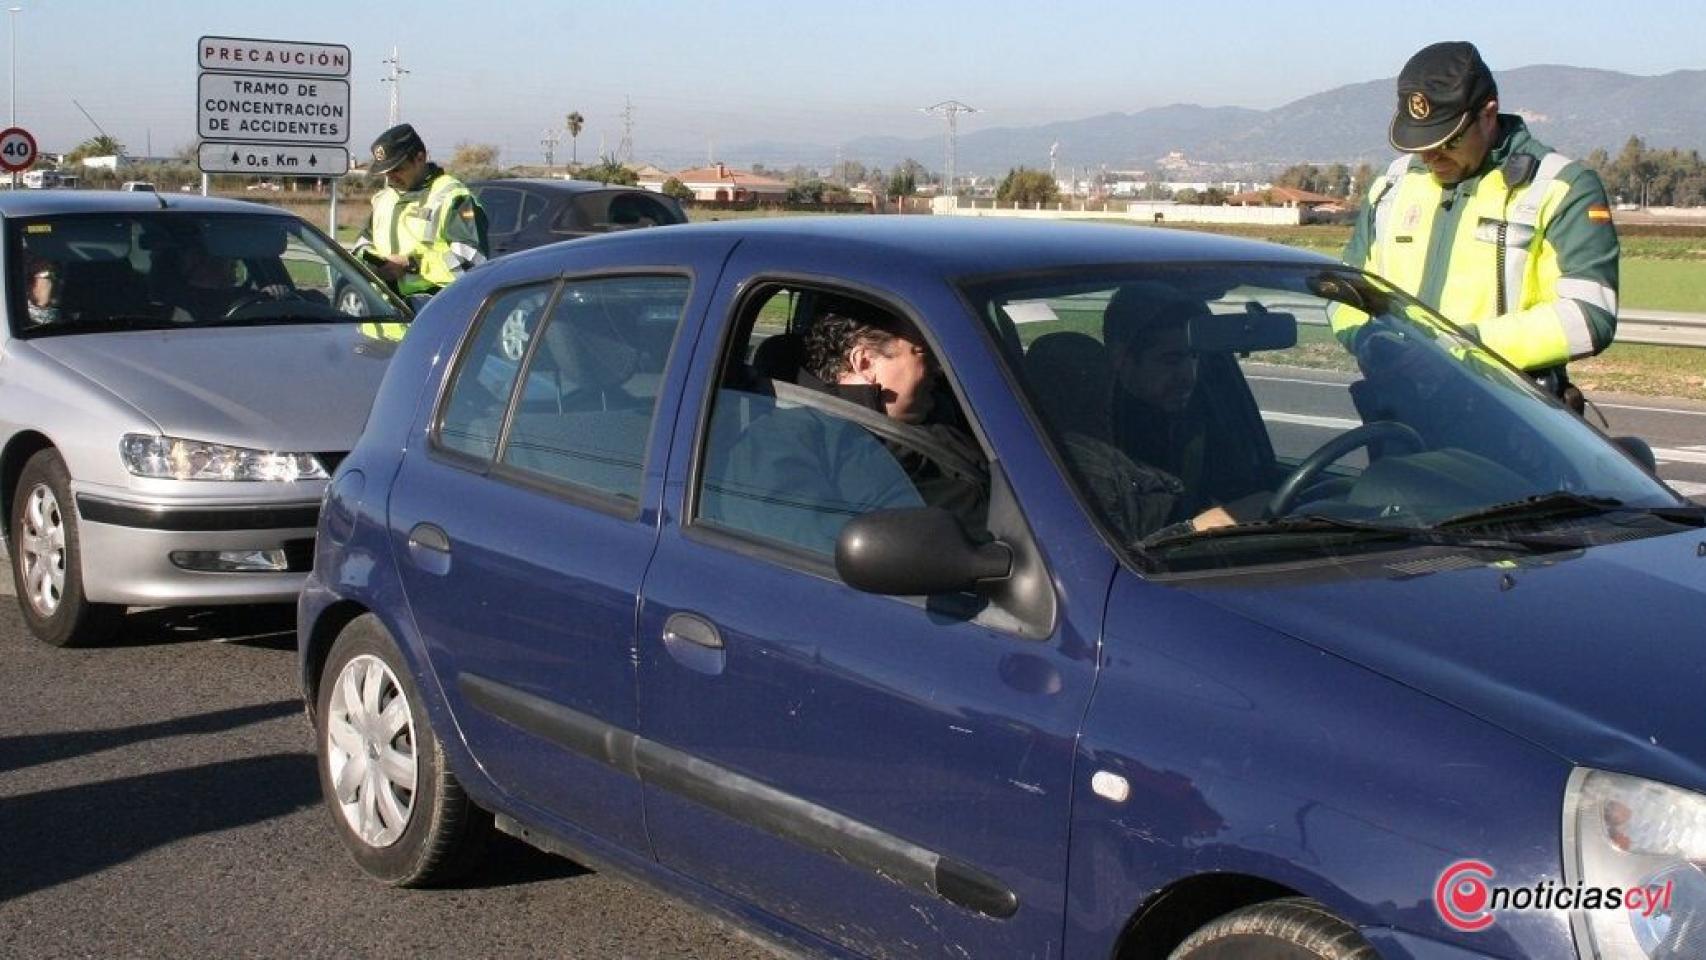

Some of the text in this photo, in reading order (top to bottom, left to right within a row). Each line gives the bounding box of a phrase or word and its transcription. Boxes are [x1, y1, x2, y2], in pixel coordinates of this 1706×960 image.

[205, 47, 344, 66] PRECAUCIÓN
[233, 80, 318, 97] TRAMO DE
[205, 99, 343, 117] CONCENTRACIÓN
[209, 118, 338, 135] DE ACCIDENTES
[3, 142, 28, 156] 40
[246, 154, 298, 167] 0,6 Km
